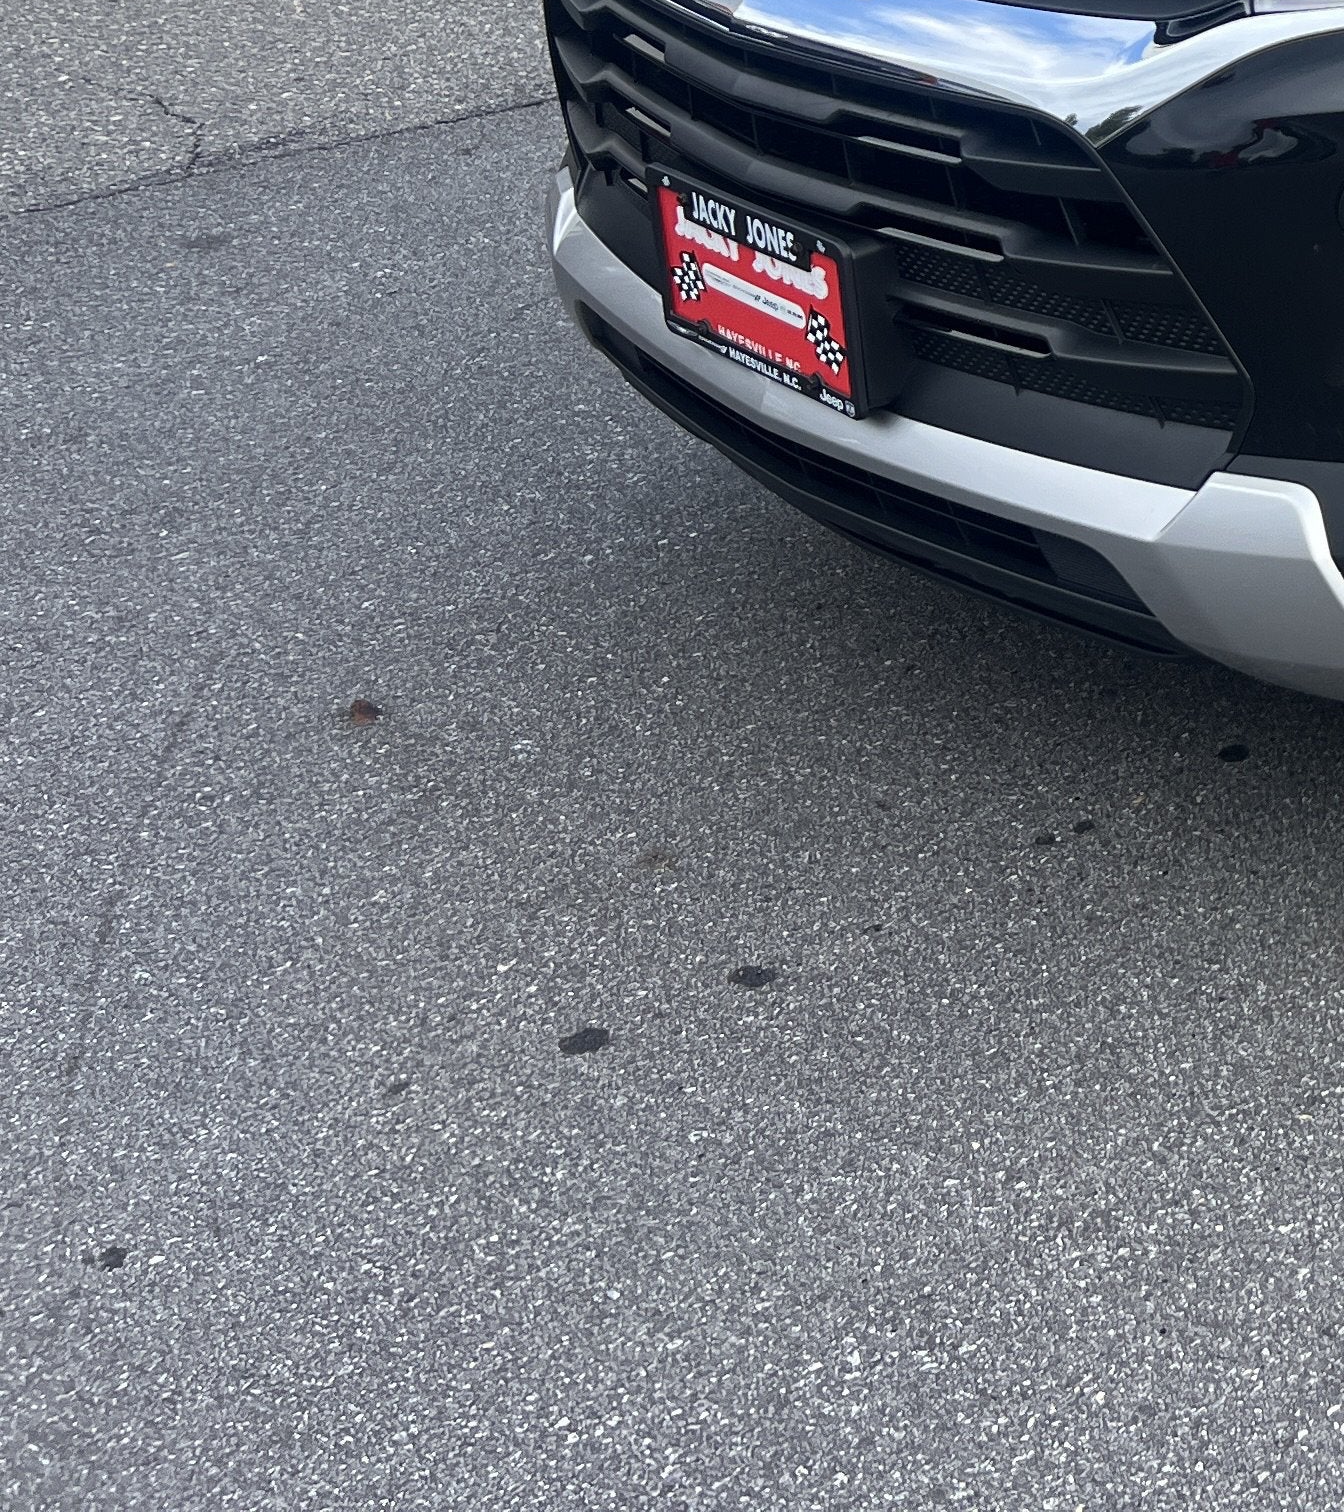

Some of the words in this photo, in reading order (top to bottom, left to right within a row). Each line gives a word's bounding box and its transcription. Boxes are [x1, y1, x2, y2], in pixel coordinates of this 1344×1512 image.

[691, 192, 736, 236] JACKY
[746, 216, 797, 261] JONES
[819, 389, 844, 412] Jeep
